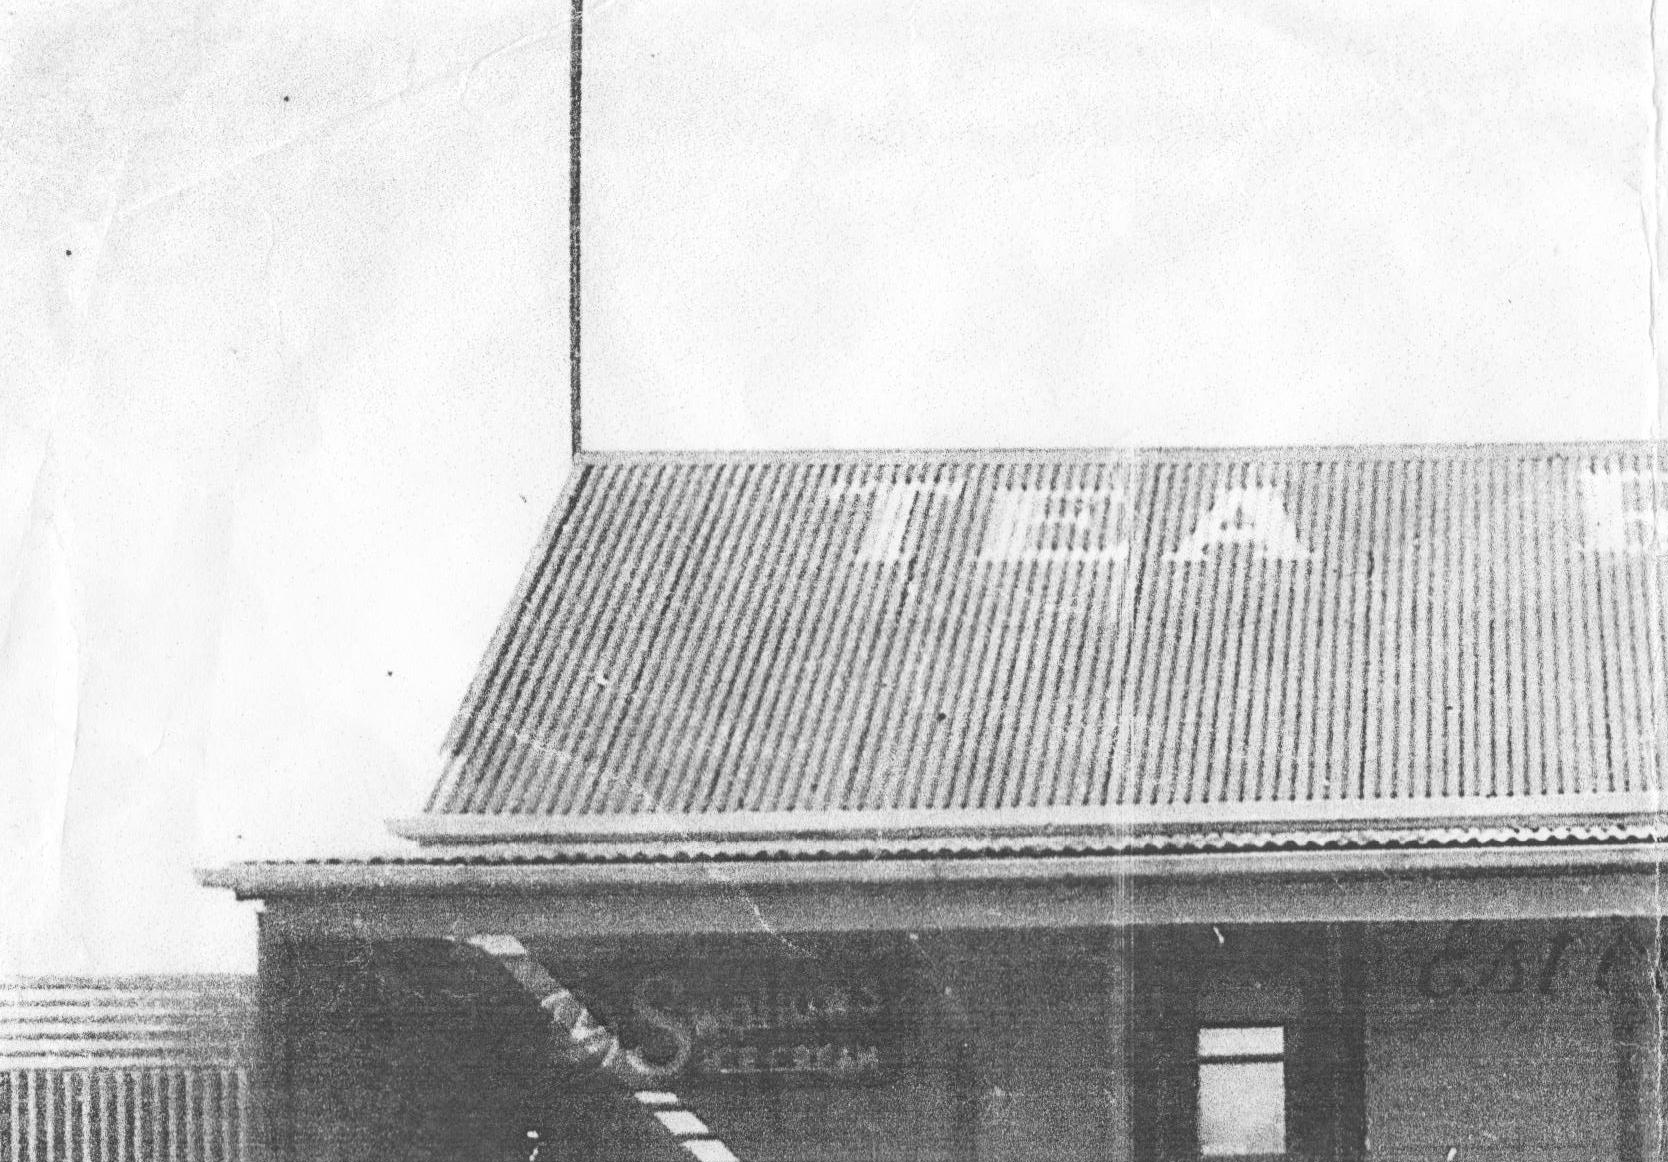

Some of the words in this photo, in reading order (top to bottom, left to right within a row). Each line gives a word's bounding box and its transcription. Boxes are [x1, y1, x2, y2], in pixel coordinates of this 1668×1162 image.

[824, 474, 1318, 565] TEA
[699, 1044, 758, 1077] ICE
[765, 1042, 881, 1076] CREAM
